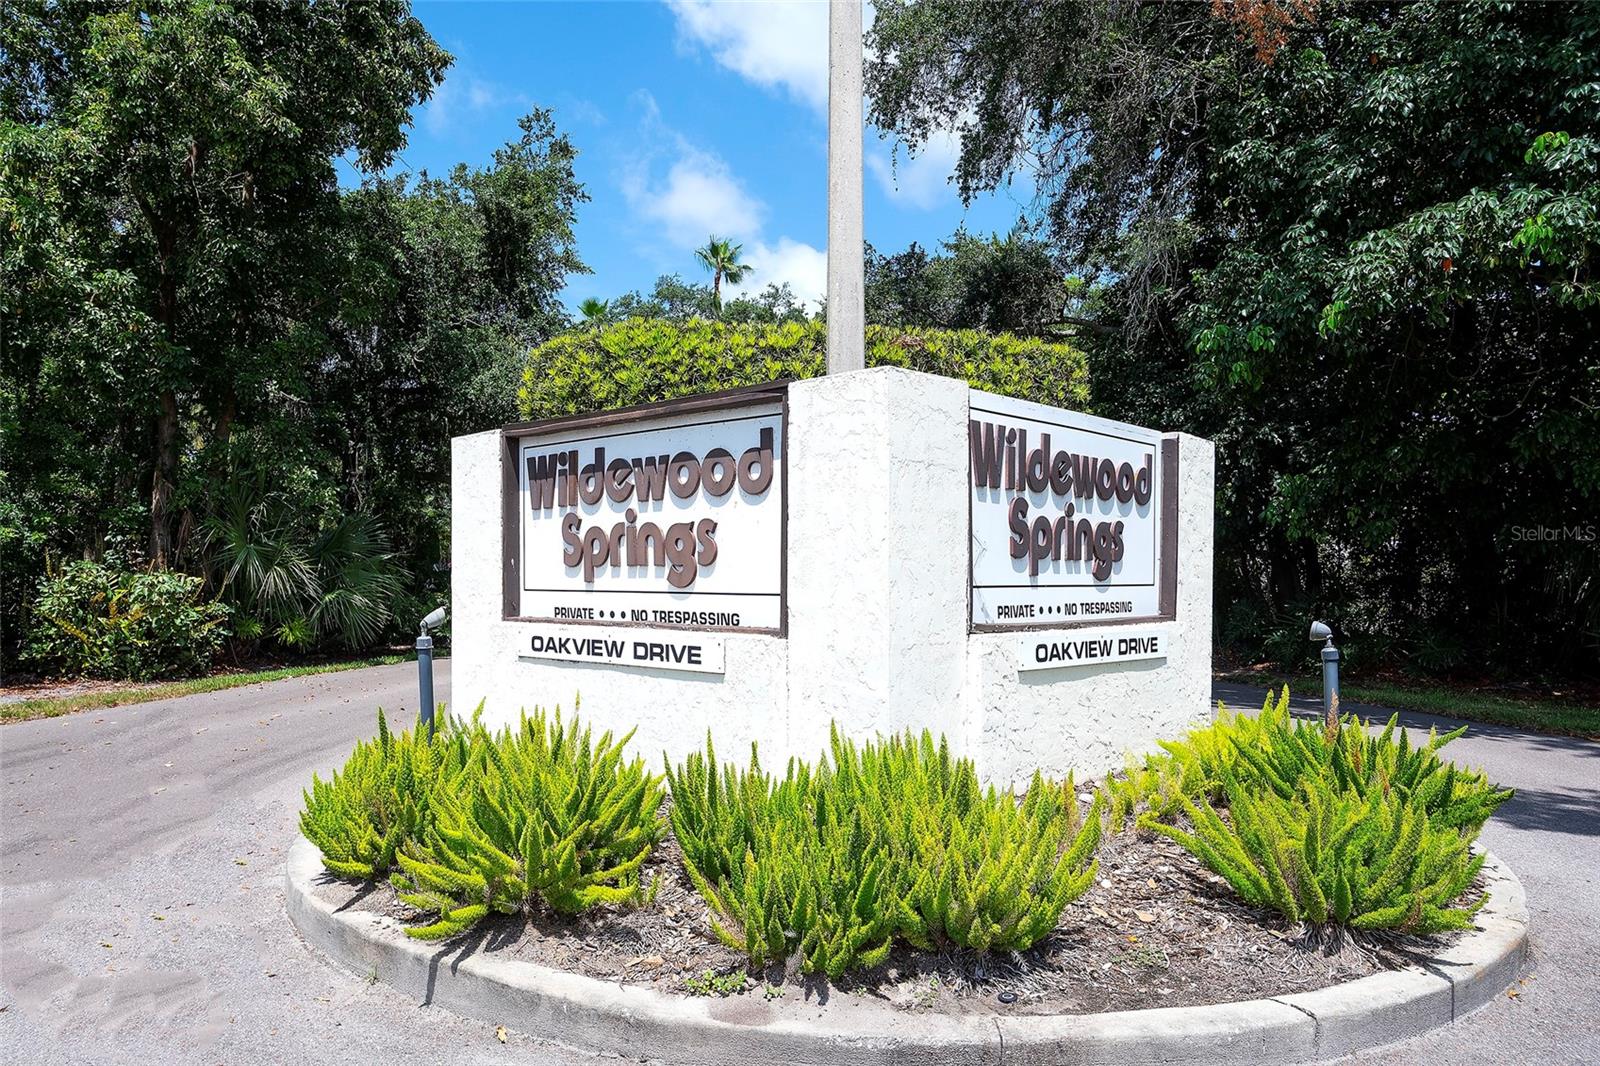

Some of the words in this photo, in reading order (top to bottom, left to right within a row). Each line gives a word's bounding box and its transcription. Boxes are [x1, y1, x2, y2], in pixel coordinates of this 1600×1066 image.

[526, 427, 774, 511] Wildewood
[970, 419, 1153, 506] Wildewood
[561, 508, 718, 588] Springs
[1009, 496, 1125, 582] Springs
[554, 607, 594, 620] PRIVATE
[631, 609, 648, 622] NO
[652, 610, 740, 626] TRESPASSING
[997, 604, 1035, 619] PRIVATE
[1064, 603, 1077, 616] NO
[1080, 601, 1133, 615] TRESPASSING
[531, 635, 625, 659] OAKVIEW
[633, 642, 702, 665] DRIVE
[1035, 640, 1113, 663] OAKVIEW
[1118, 637, 1158, 656] DRIVE
